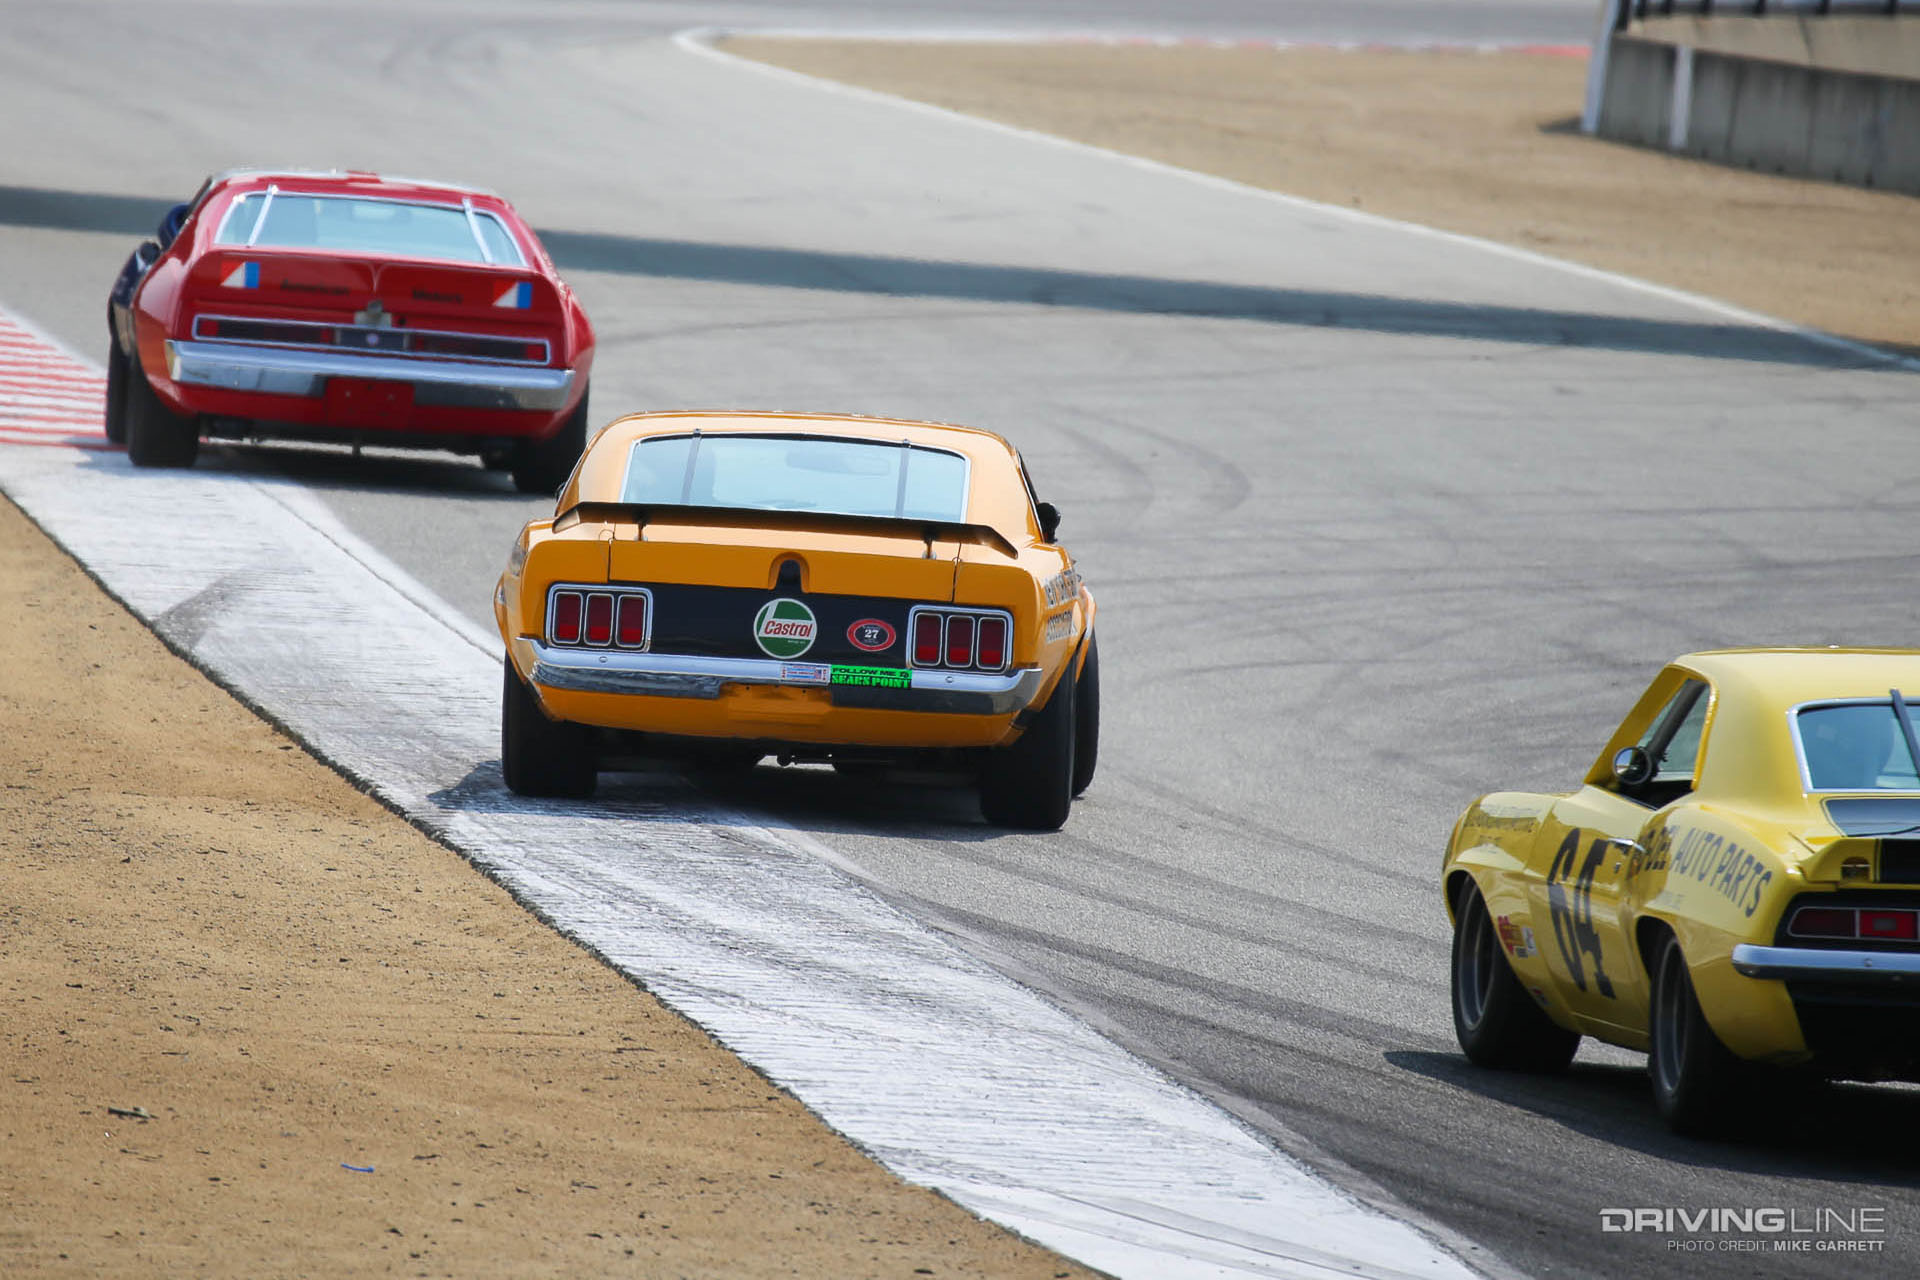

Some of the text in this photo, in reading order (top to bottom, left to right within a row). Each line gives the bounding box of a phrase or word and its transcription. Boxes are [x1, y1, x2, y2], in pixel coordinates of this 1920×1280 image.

[764, 620, 812, 638] Castrol
[864, 629, 879, 639] 27
[832, 667, 878, 675] FOLLOW
[831, 674, 911, 689] SEARS POINT
[1669, 827, 1724, 882] AUTO
[1708, 843, 1773, 918] PARTS
[1547, 827, 1617, 999] 64
